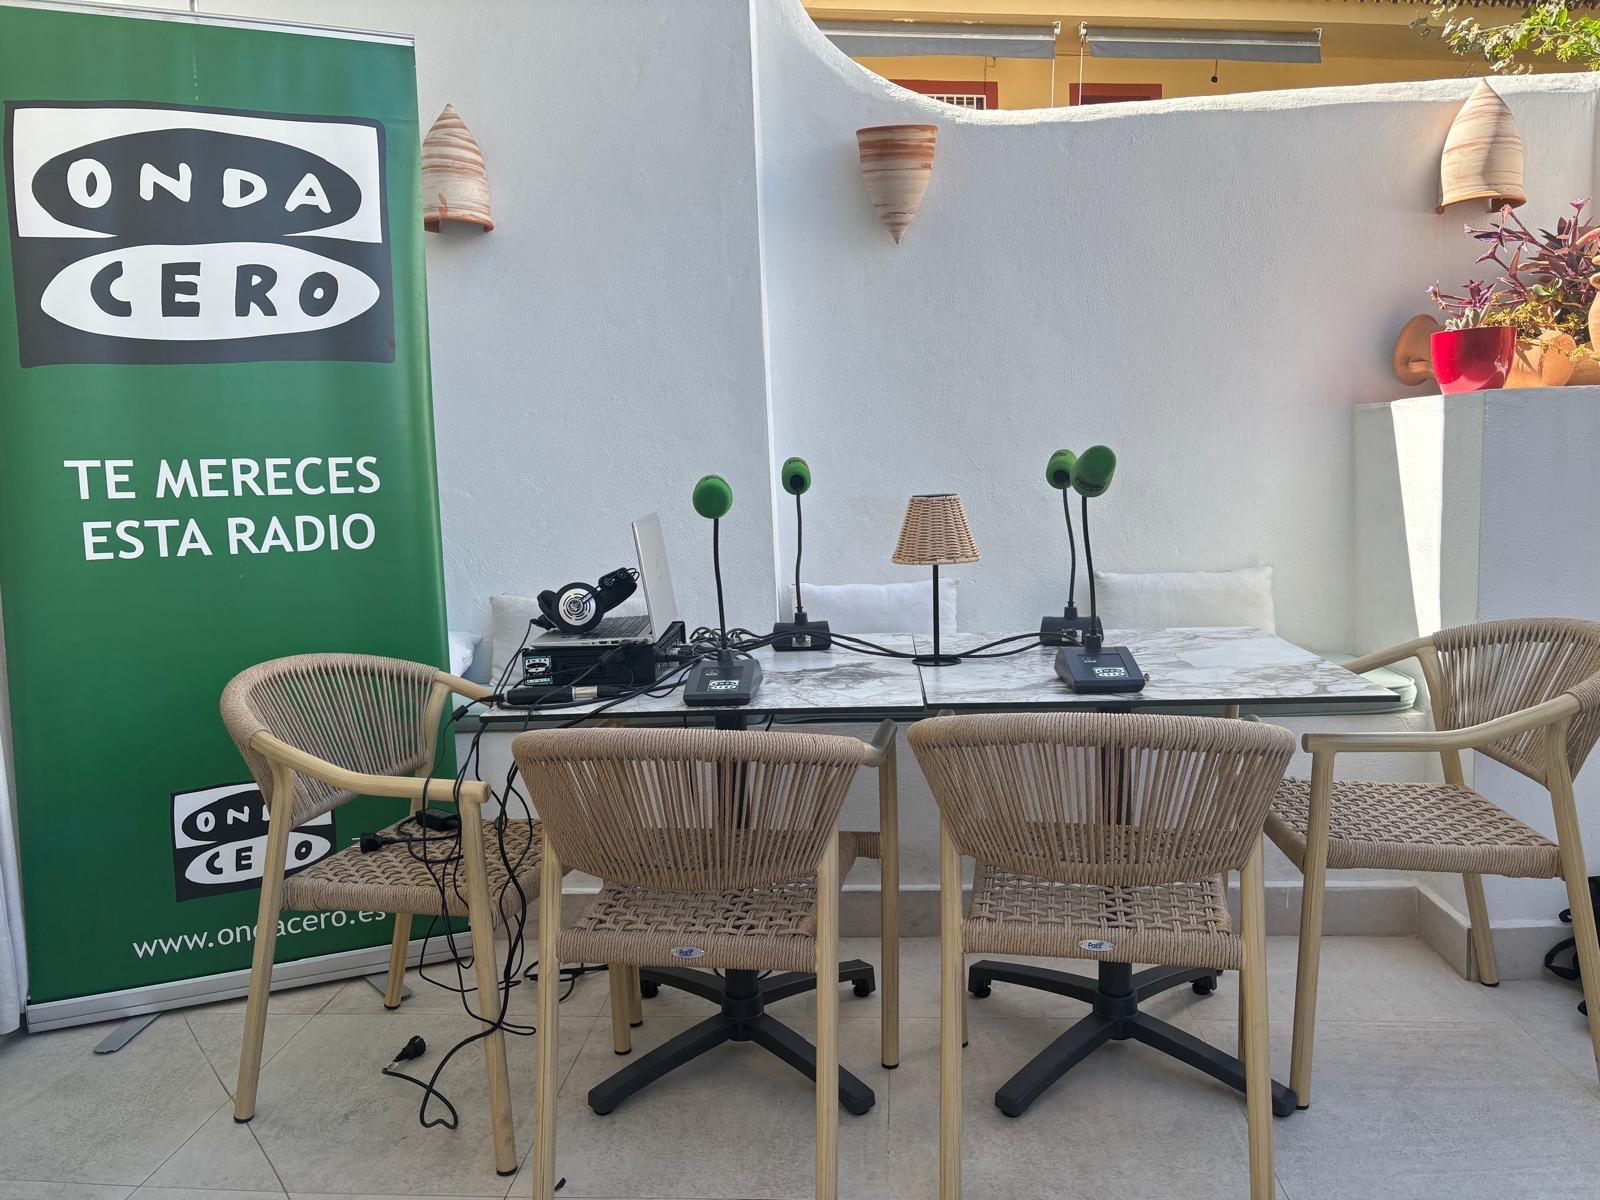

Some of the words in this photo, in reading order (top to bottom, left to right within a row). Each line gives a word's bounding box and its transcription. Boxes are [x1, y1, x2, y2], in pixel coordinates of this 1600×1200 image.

[66, 158, 332, 214] ONDA
[90, 260, 339, 318] CERO
[63, 459, 136, 500] TE
[155, 455, 381, 499] MERECES
[82, 517, 213, 561] ESTA
[227, 513, 376, 555] RADIO
[196, 804, 270, 833] ON
[205, 839, 313, 875] CEO
